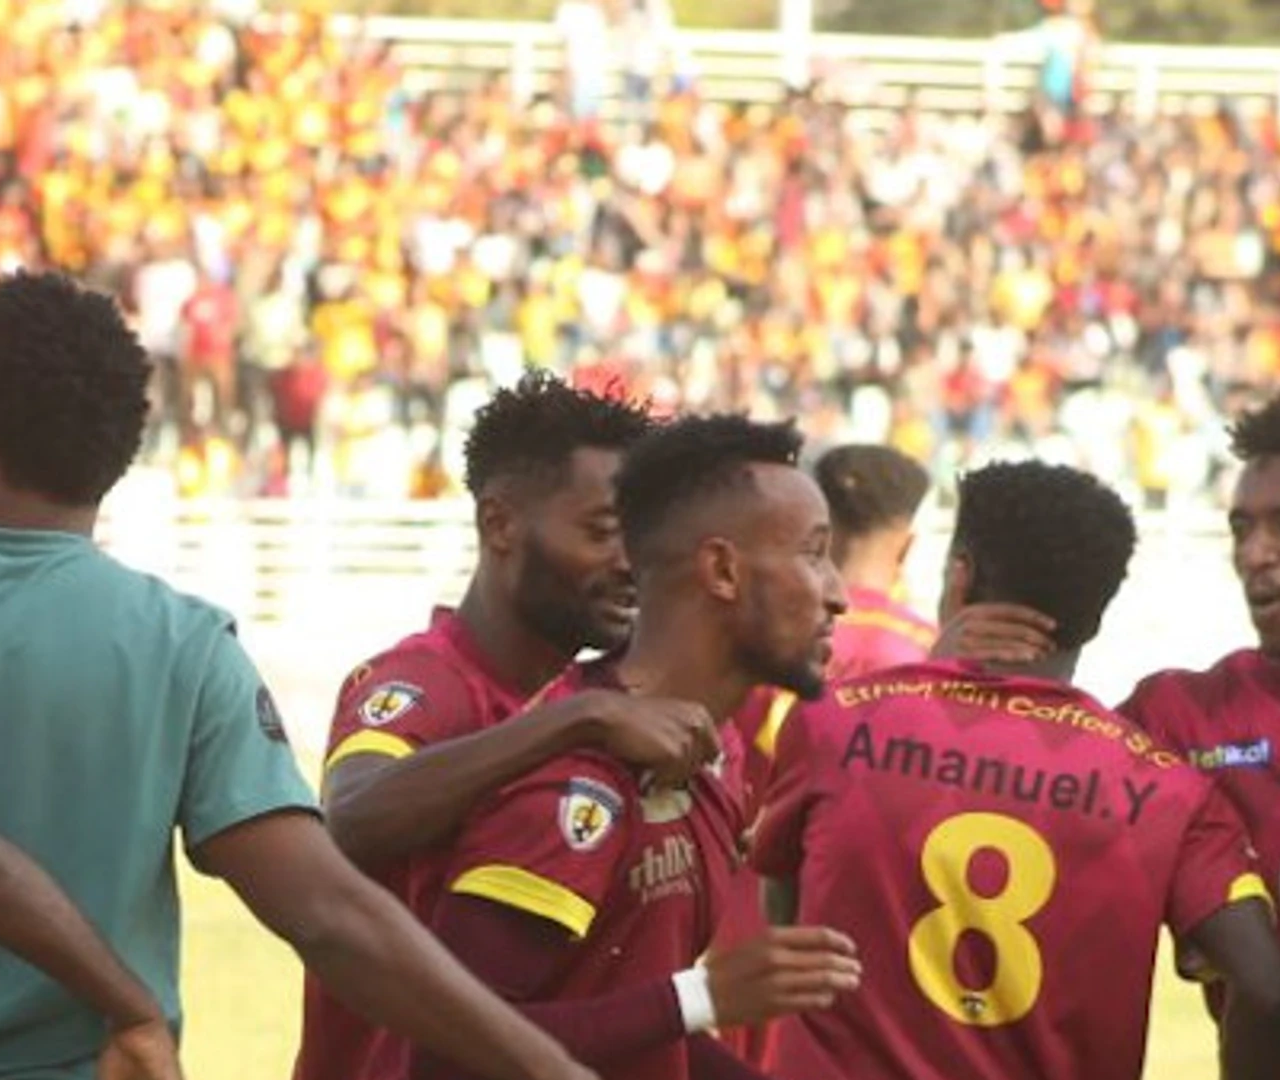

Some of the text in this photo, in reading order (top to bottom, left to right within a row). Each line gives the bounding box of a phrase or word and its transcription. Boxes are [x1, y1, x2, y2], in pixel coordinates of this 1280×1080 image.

[1006, 695, 1122, 740] Coffee
[839, 720, 1159, 826] Amanuel.Y
[907, 810, 1057, 1029] 8
